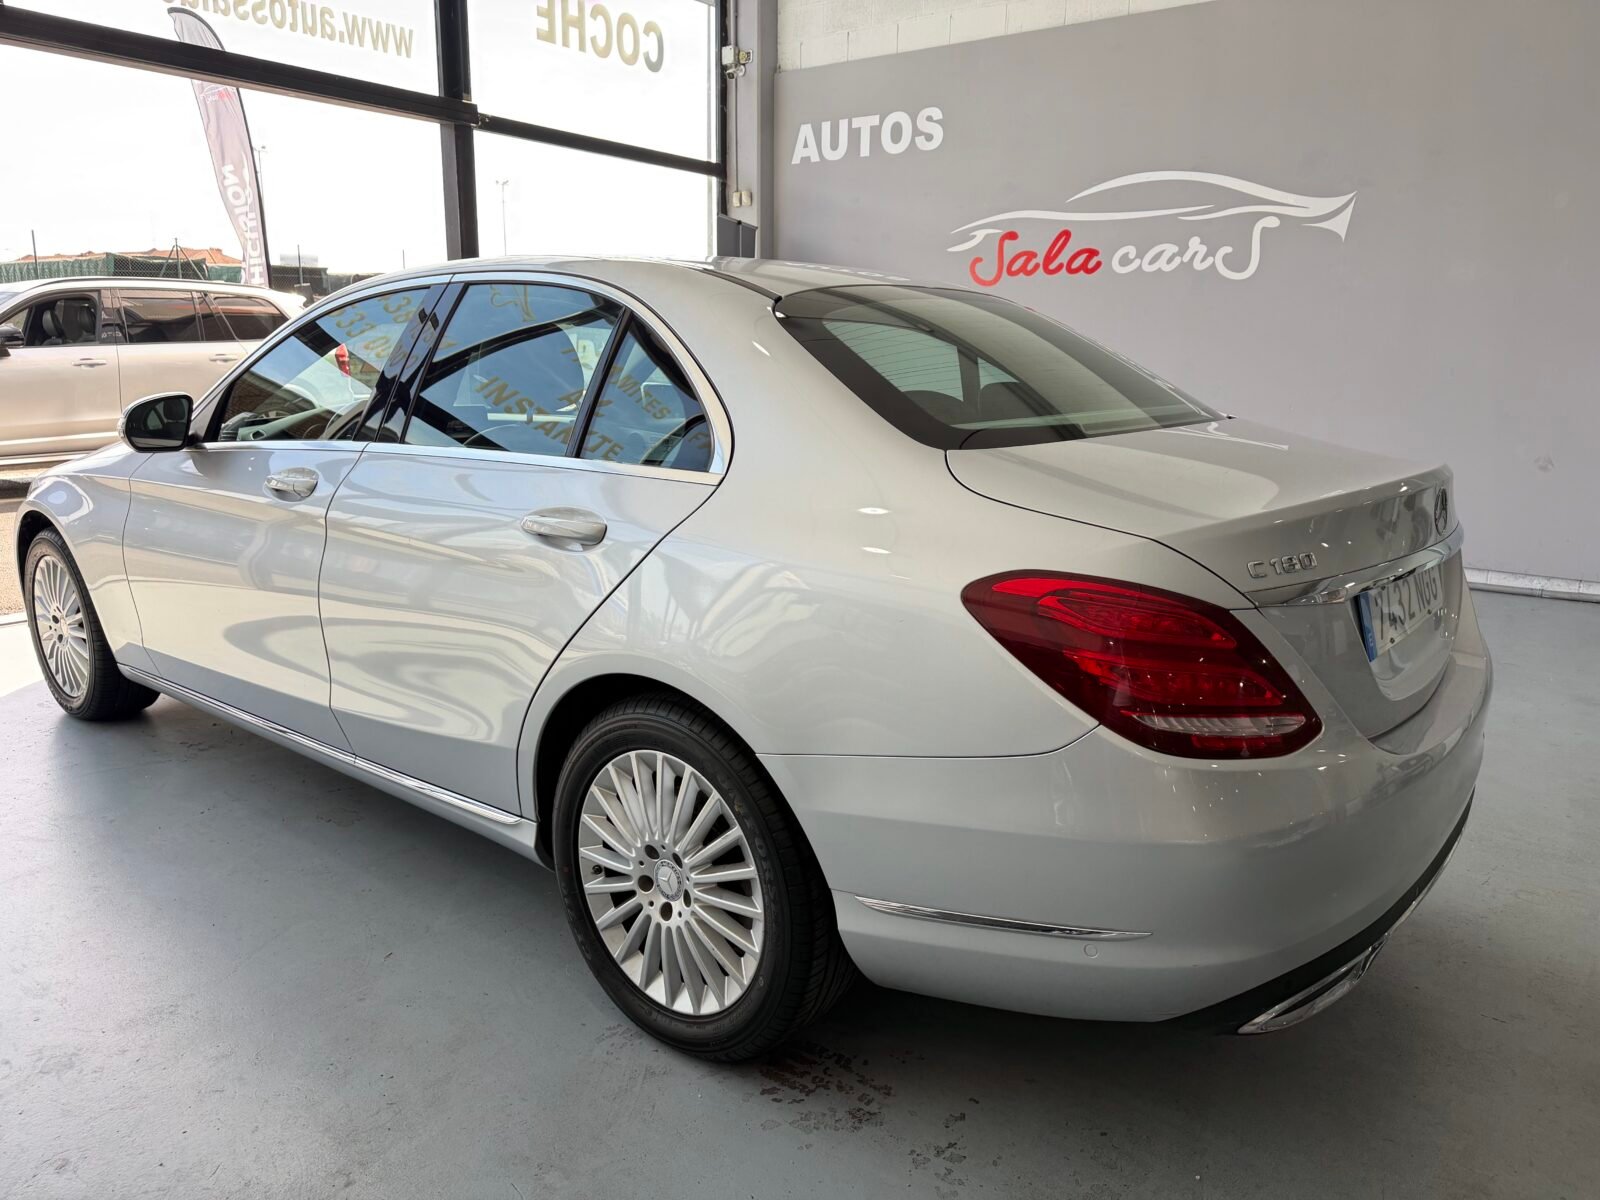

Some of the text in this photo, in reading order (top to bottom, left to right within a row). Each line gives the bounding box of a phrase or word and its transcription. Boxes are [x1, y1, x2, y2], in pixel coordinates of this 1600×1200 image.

[791, 106, 944, 164] AUTOS
[969, 229, 1103, 287] Sala
[1247, 552, 1318, 579] C 180
[1374, 579, 1415, 640] 7432
